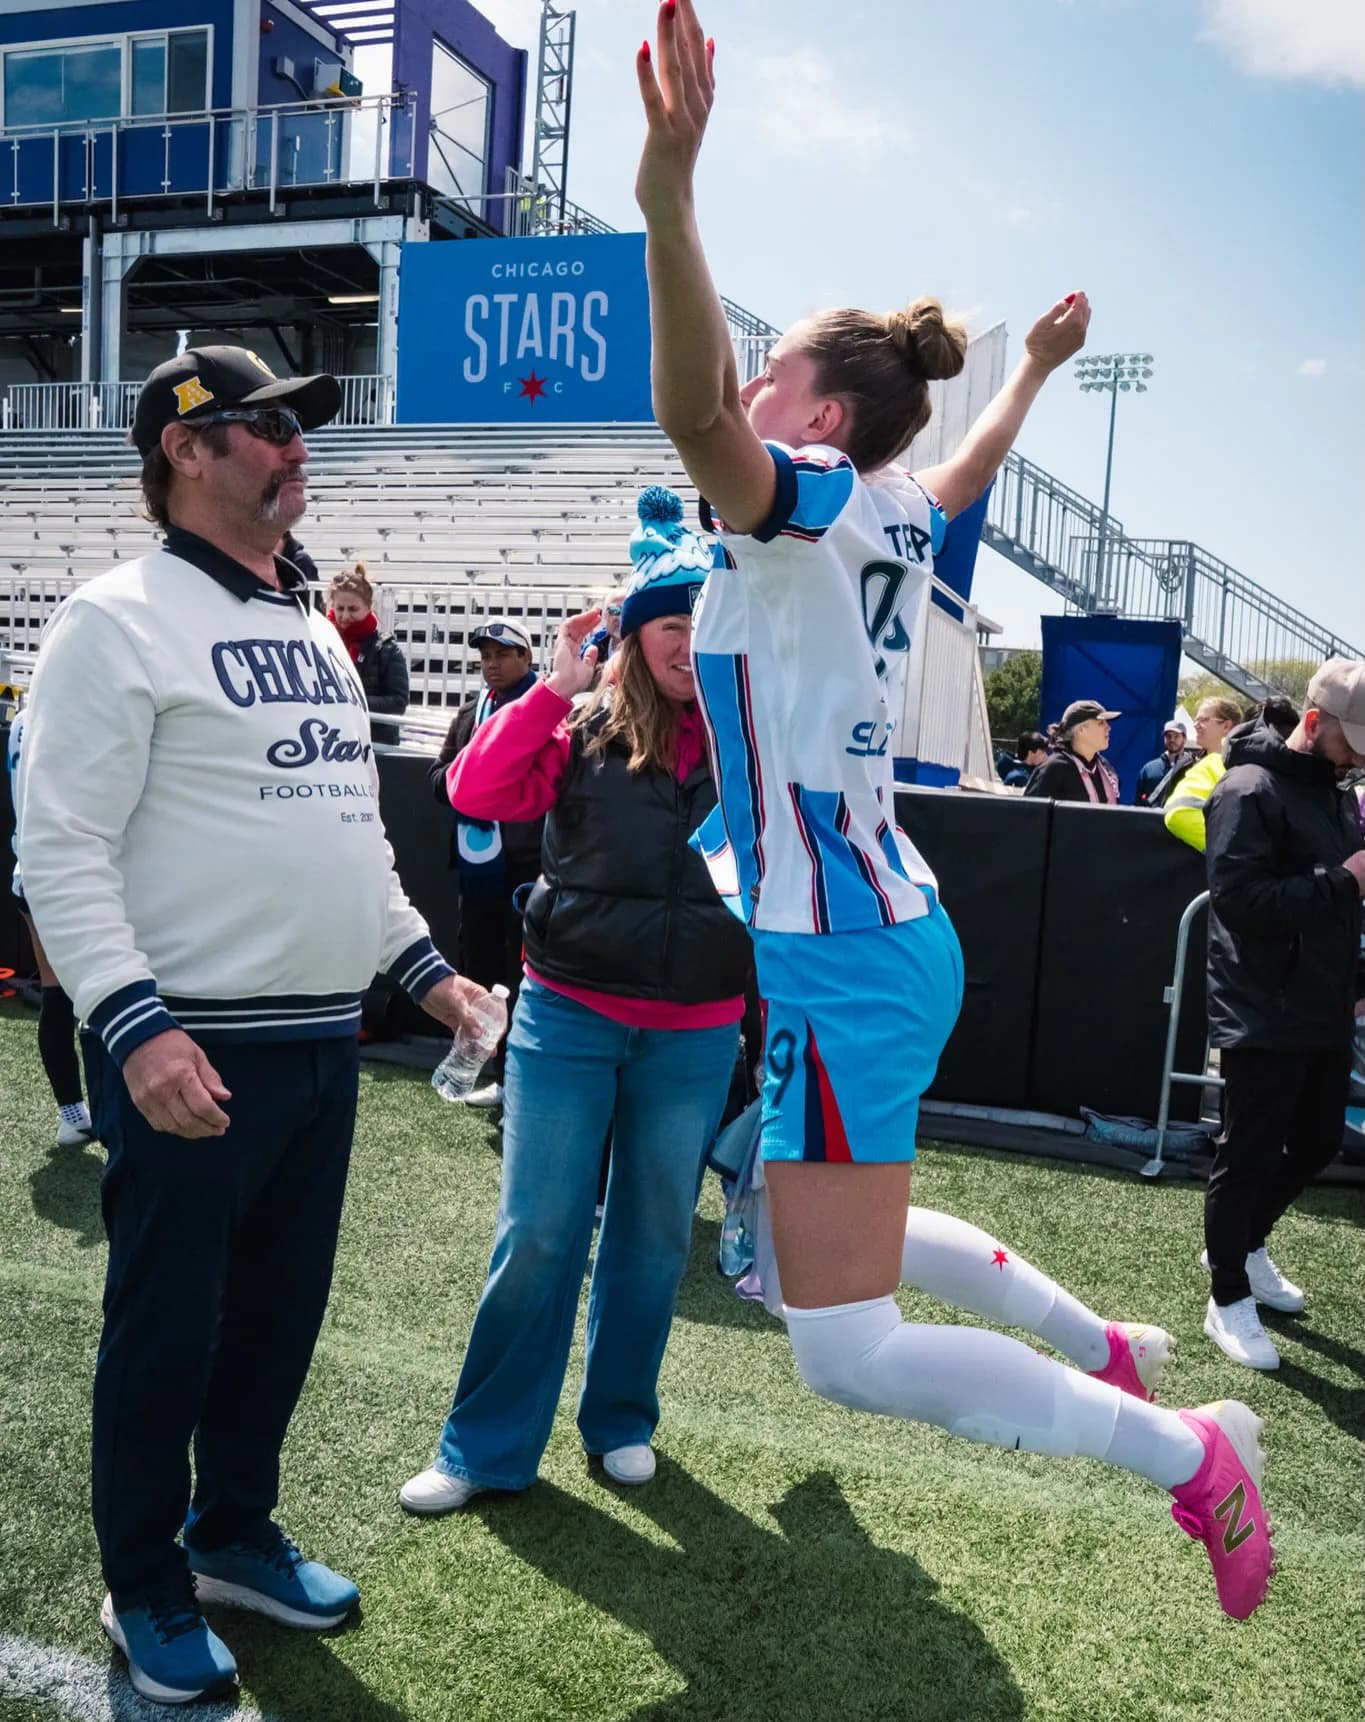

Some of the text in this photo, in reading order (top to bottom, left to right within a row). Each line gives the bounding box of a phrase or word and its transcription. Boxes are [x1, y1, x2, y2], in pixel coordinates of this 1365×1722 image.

[491, 261, 585, 278] CHICAGO
[463, 290, 609, 383] STARS
[503, 382, 563, 393] F C
[260, 783, 368, 800] FOOTBALL
[768, 1029, 797, 1107] 9
[1213, 1480, 1256, 1554] N
